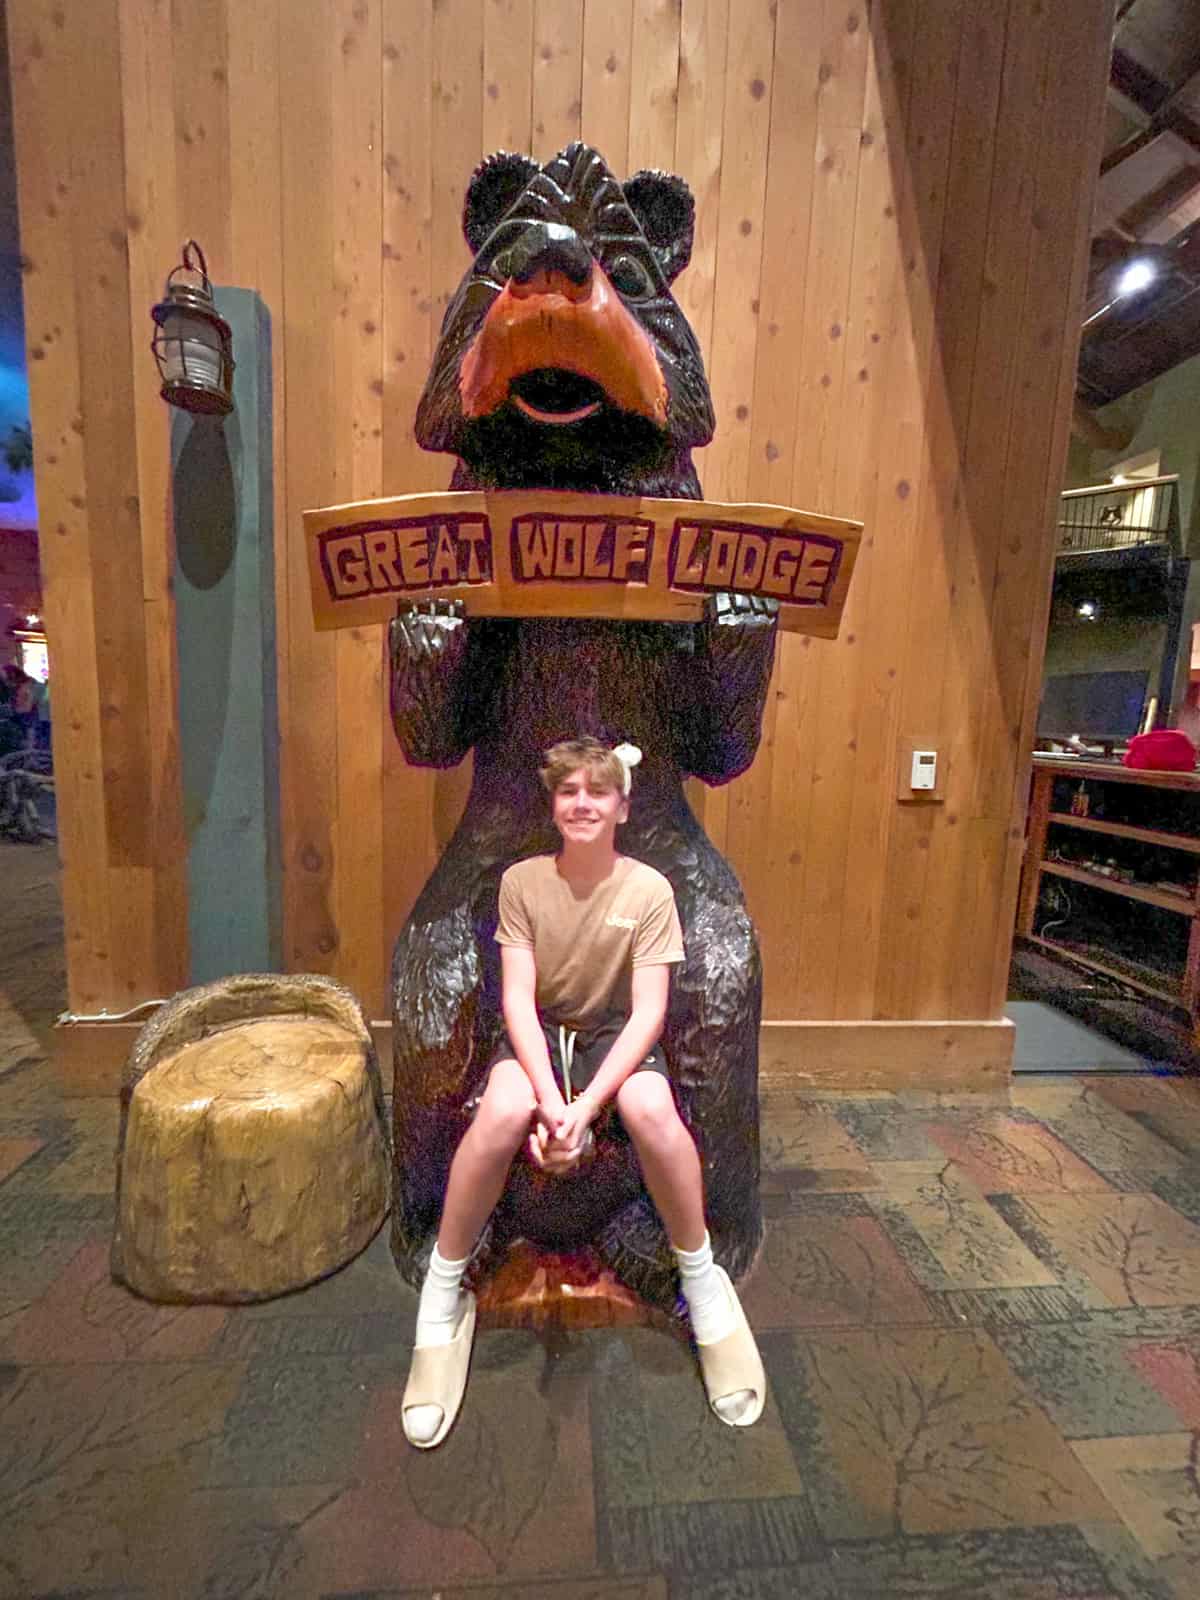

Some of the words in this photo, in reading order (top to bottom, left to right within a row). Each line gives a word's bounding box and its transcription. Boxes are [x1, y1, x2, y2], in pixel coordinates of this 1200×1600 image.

[326, 522, 489, 598] GREAT
[517, 521, 651, 585] WOLF
[675, 523, 836, 600] LODGE
